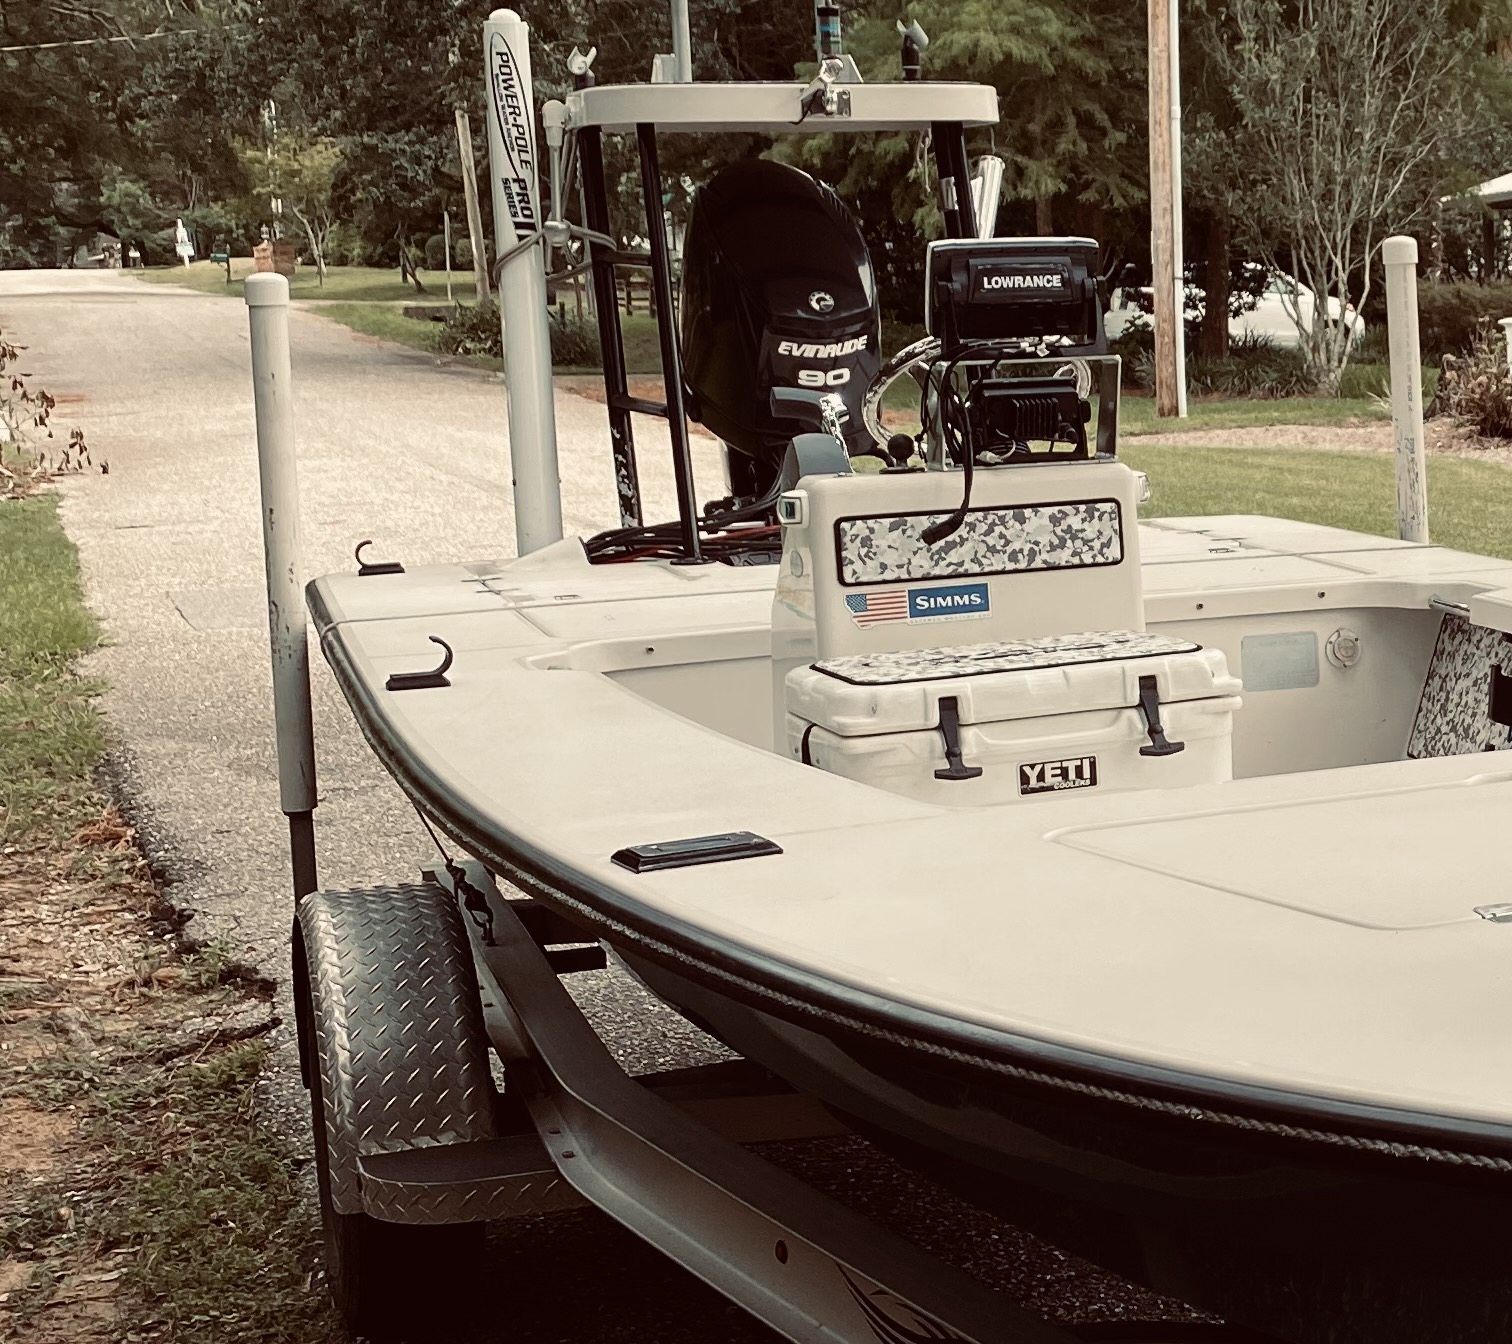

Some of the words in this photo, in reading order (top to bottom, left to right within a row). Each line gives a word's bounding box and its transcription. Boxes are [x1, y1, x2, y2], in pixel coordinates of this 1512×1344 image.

[495, 51, 533, 171] POWER-POLE
[501, 177, 520, 218] SERIES
[511, 177, 535, 219] PRO
[983, 274, 1062, 289] LOWRANCE
[778, 335, 868, 359] EVINRUDE
[798, 367, 851, 387] 90
[915, 592, 983, 610] SIMMS
[1022, 758, 1091, 788] YETI
